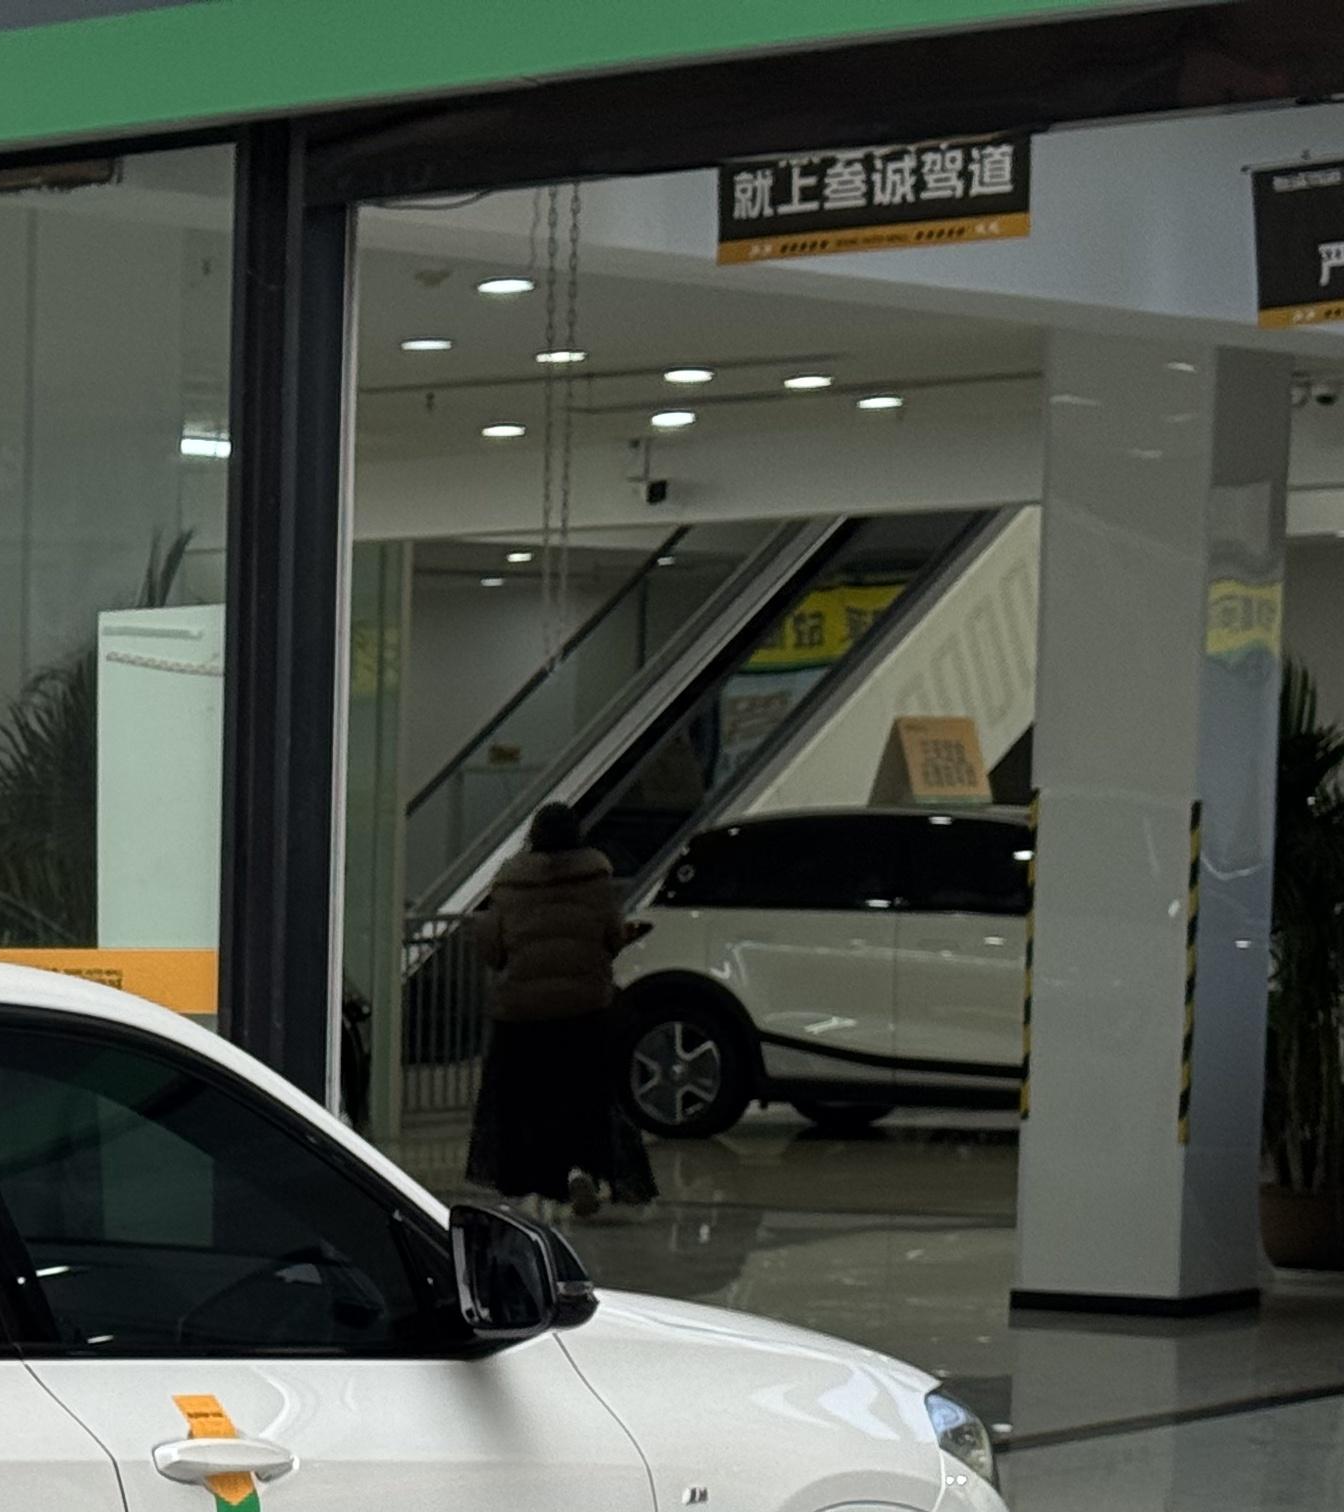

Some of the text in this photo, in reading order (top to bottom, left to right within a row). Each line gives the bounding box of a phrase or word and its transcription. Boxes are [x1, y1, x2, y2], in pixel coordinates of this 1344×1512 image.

[732, 145, 1014, 219] 就上叁诚驾道
